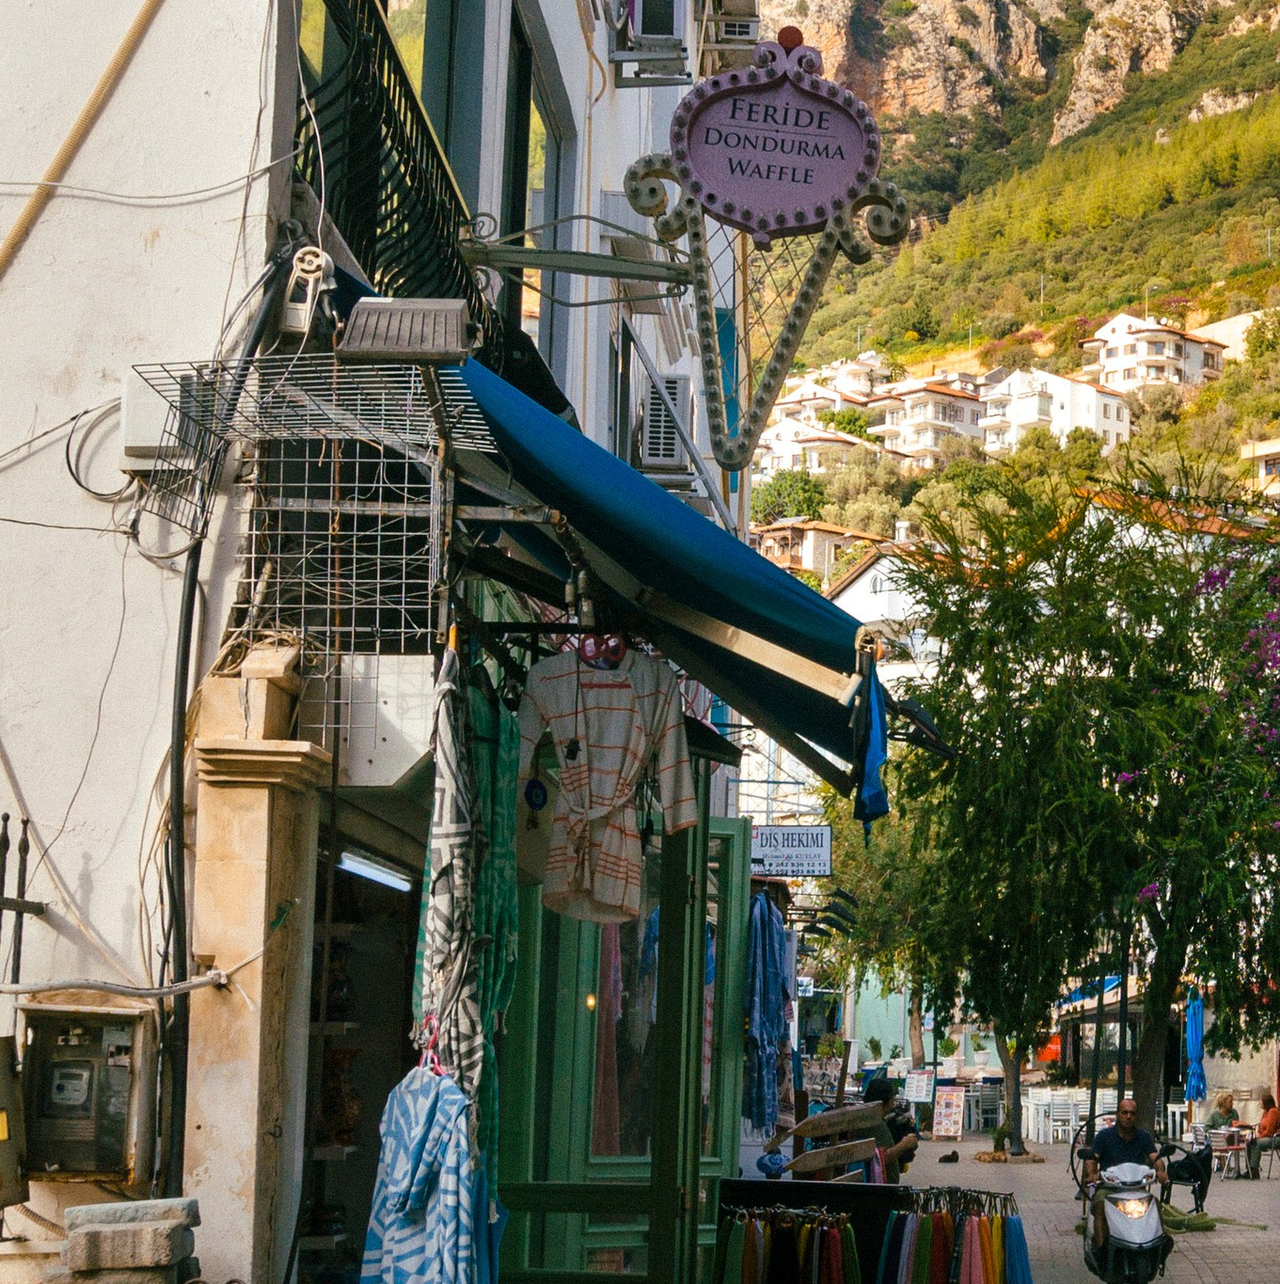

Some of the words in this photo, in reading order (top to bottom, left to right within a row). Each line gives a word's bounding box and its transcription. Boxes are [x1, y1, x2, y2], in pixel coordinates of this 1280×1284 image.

[704, 127, 846, 160] DONDURMA
[728, 157, 815, 184] WAFFLE
[782, 828, 825, 848] HEKİMİ
